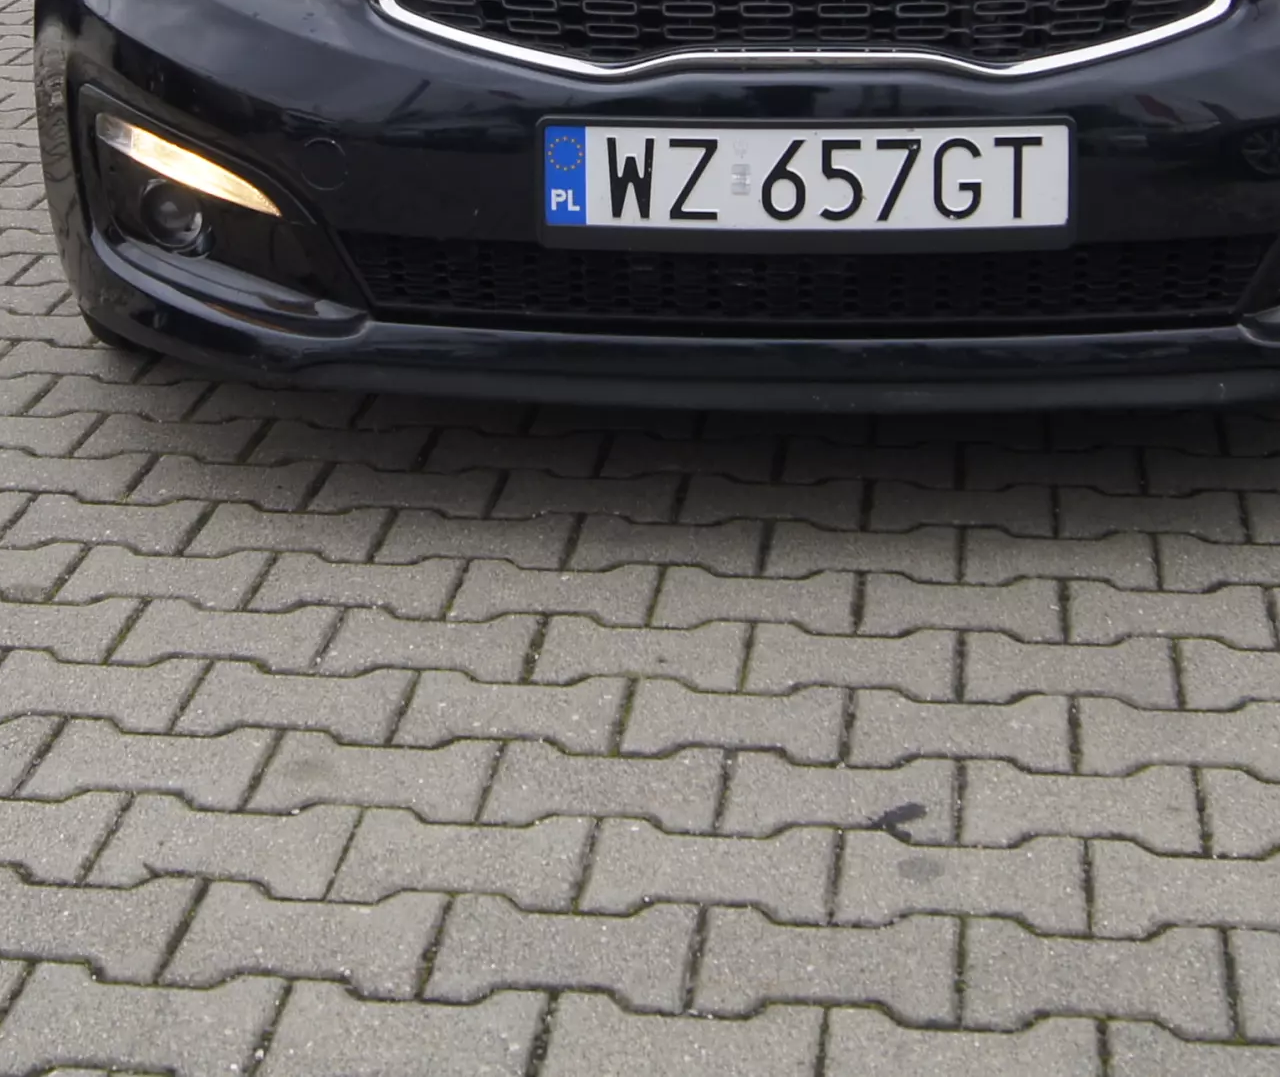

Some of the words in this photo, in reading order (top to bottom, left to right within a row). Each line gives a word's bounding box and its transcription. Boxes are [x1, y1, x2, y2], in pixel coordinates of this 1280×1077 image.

[551, 188, 581, 213] PL
[605, 136, 719, 221] WZ
[760, 135, 1043, 222] 657GT
